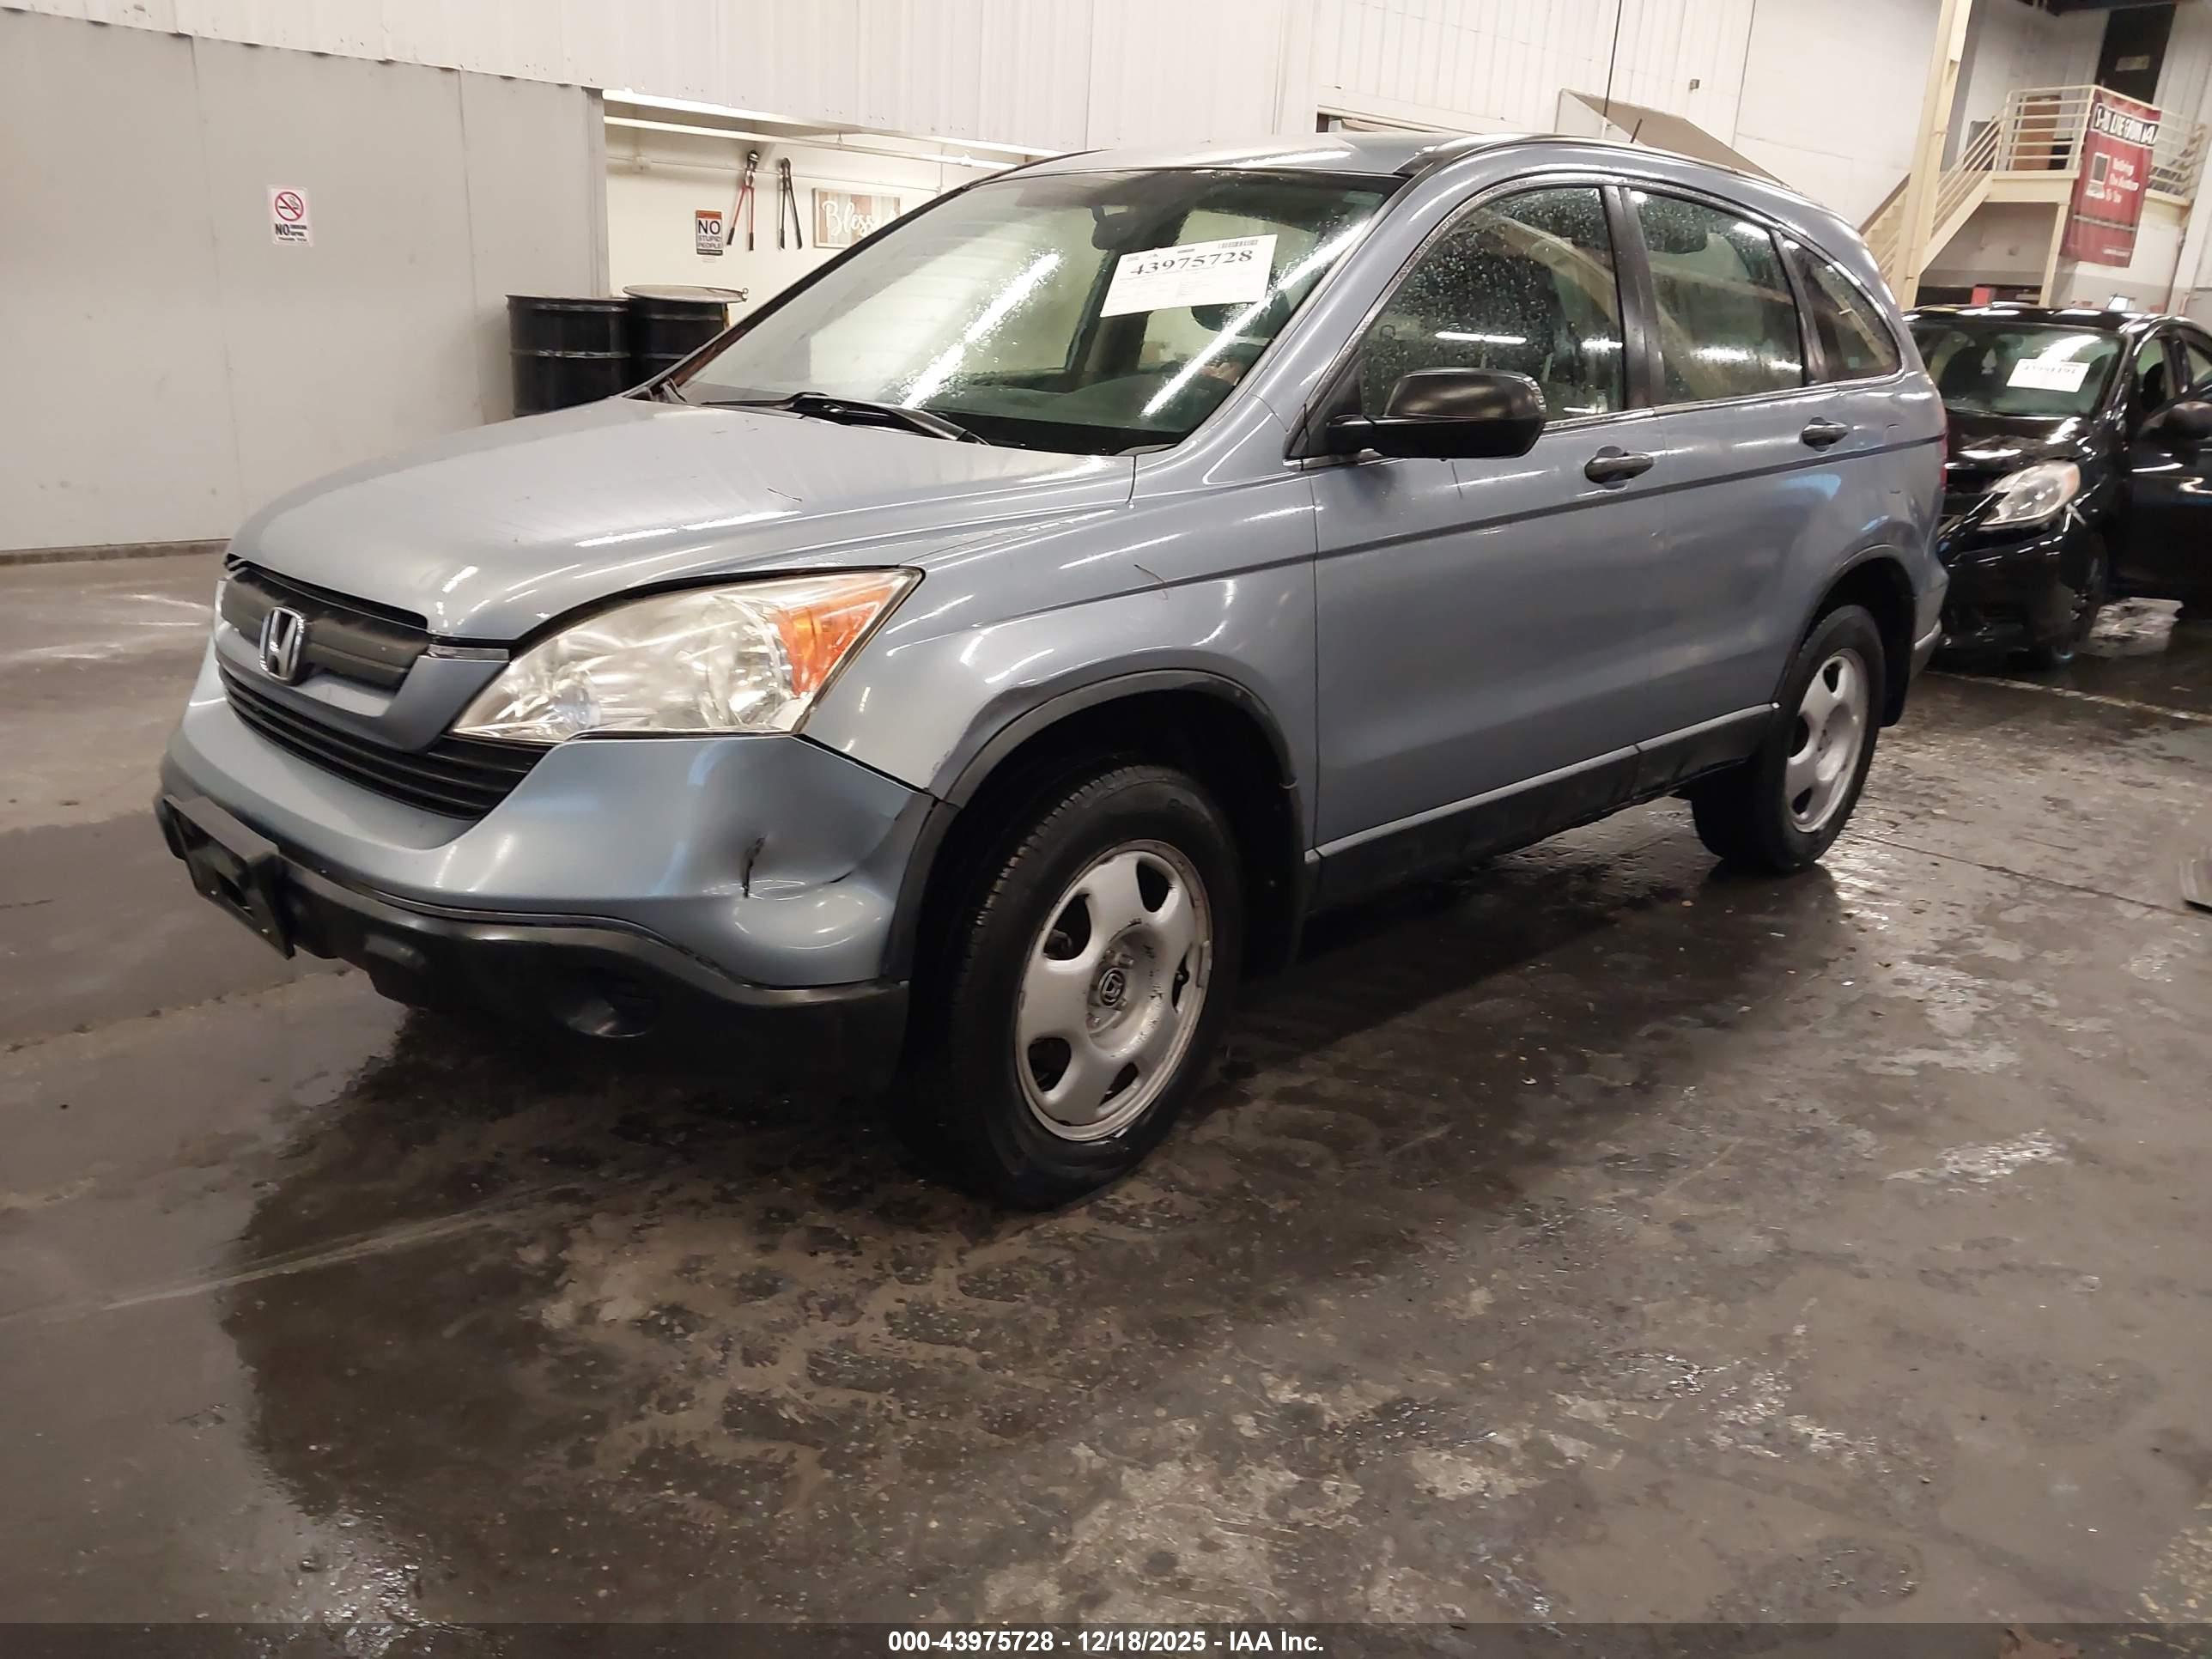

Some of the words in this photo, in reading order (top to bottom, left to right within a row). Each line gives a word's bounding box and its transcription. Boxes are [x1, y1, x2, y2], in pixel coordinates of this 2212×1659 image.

[698, 220, 720, 234] NO
[822, 201, 896, 237] Bless
[276, 223, 290, 235] NO
[1130, 250, 1253, 275] 43975728
